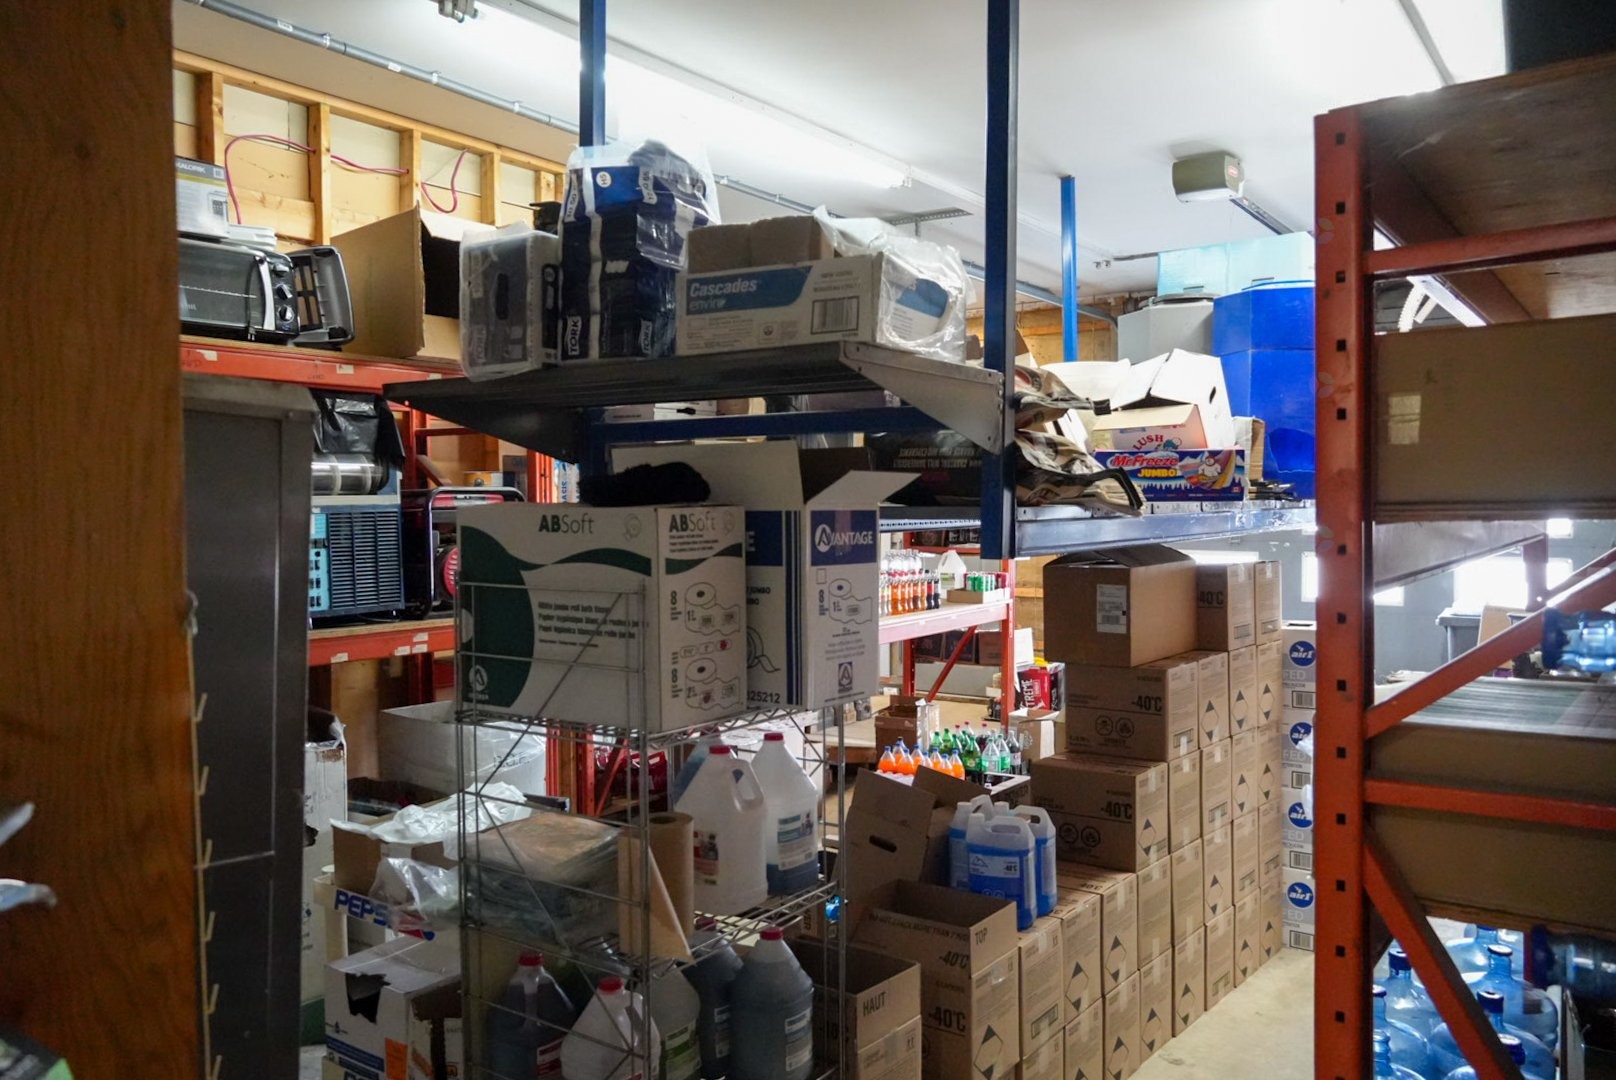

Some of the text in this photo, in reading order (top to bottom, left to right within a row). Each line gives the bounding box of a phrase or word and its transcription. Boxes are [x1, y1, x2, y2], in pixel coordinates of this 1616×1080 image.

[690, 278, 757, 298] Cascades
[569, 319, 581, 354] TORK
[1133, 434, 1164, 450] LUSH
[1137, 468, 1178, 477] JUMBO
[538, 513, 595, 534] ABSoft
[669, 510, 716, 533] ABSoft
[815, 525, 874, 551] AVANTAGE
[1198, 589, 1225, 606] 40°C
[334, 889, 391, 928] PEPS
[863, 991, 886, 1017] HAUT
